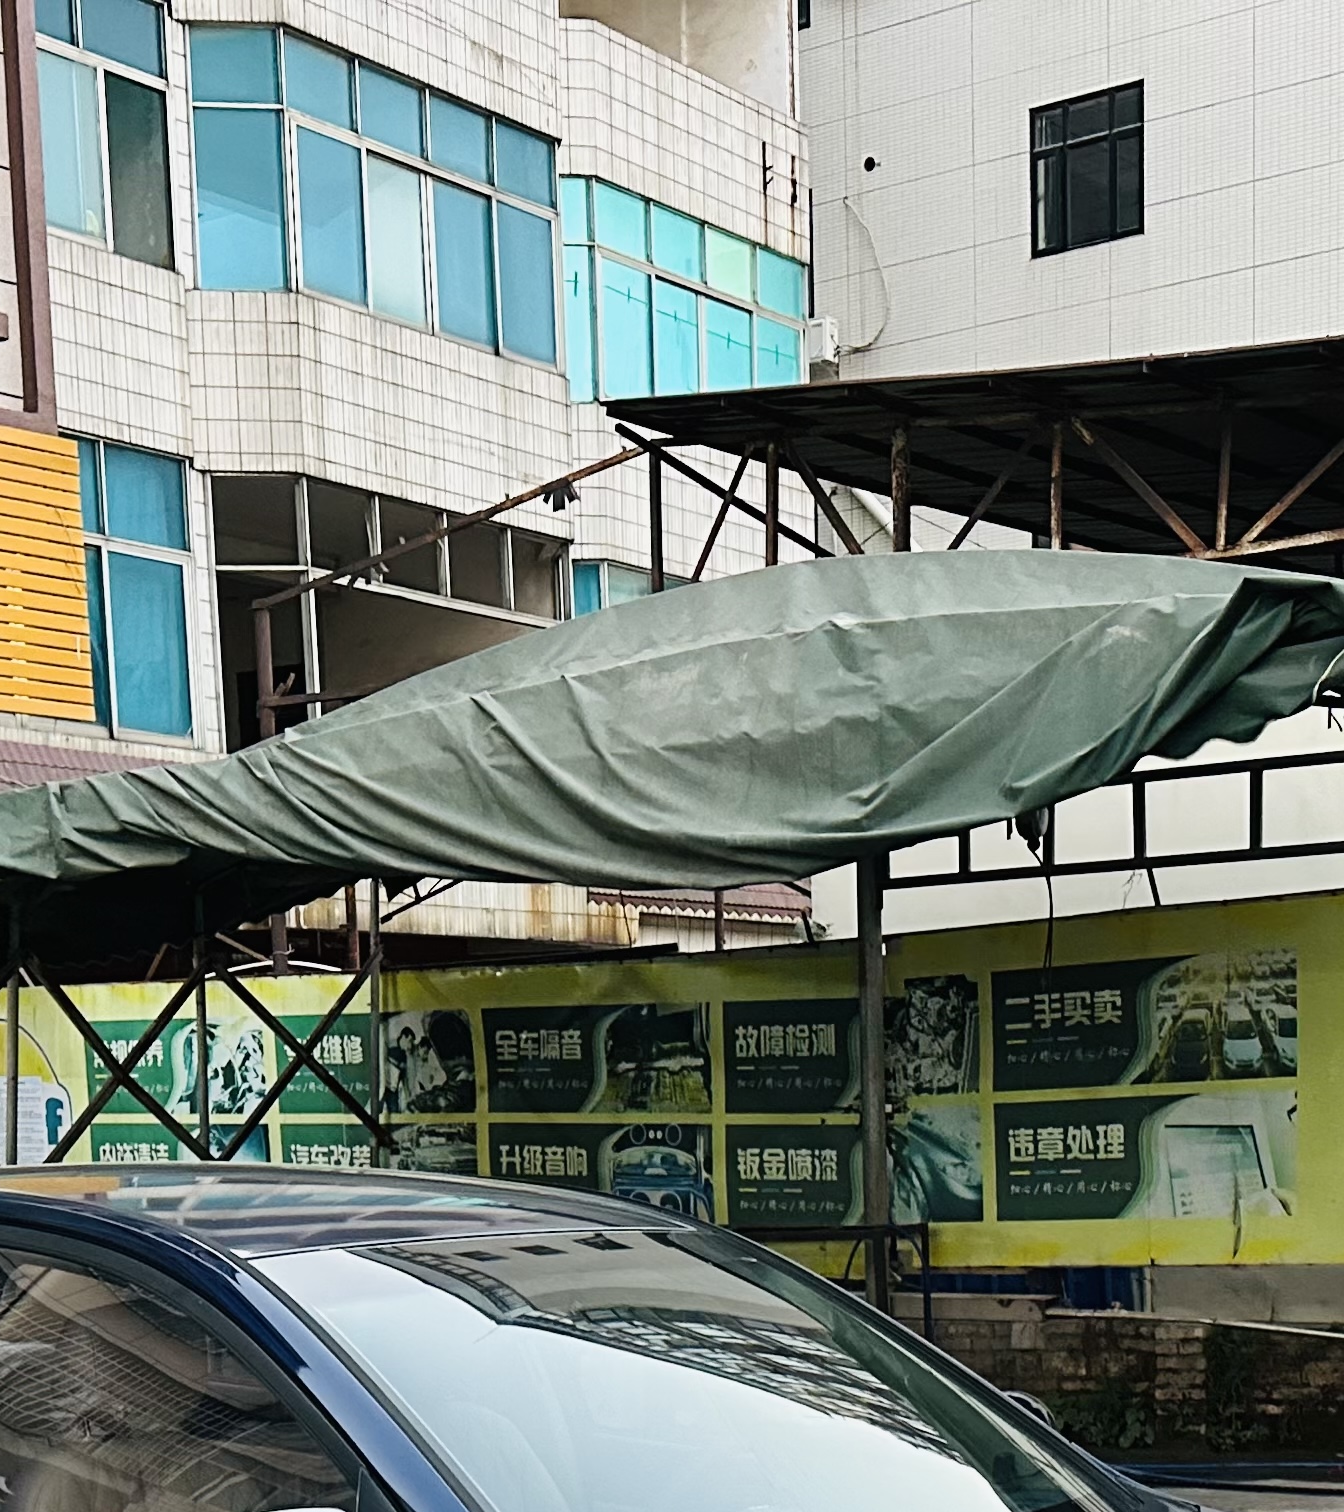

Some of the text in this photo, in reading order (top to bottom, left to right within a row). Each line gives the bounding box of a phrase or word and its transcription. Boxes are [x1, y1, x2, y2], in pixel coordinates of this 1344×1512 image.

[1005, 988, 1123, 1030] 二手买卖
[495, 1029, 582, 1061] 全车隔音
[735, 1024, 836, 1057] 故障检测
[1008, 1123, 1125, 1163] 违章处理
[499, 1144, 588, 1176] 升级音响
[737, 1147, 838, 1181] 钣金喷漆
